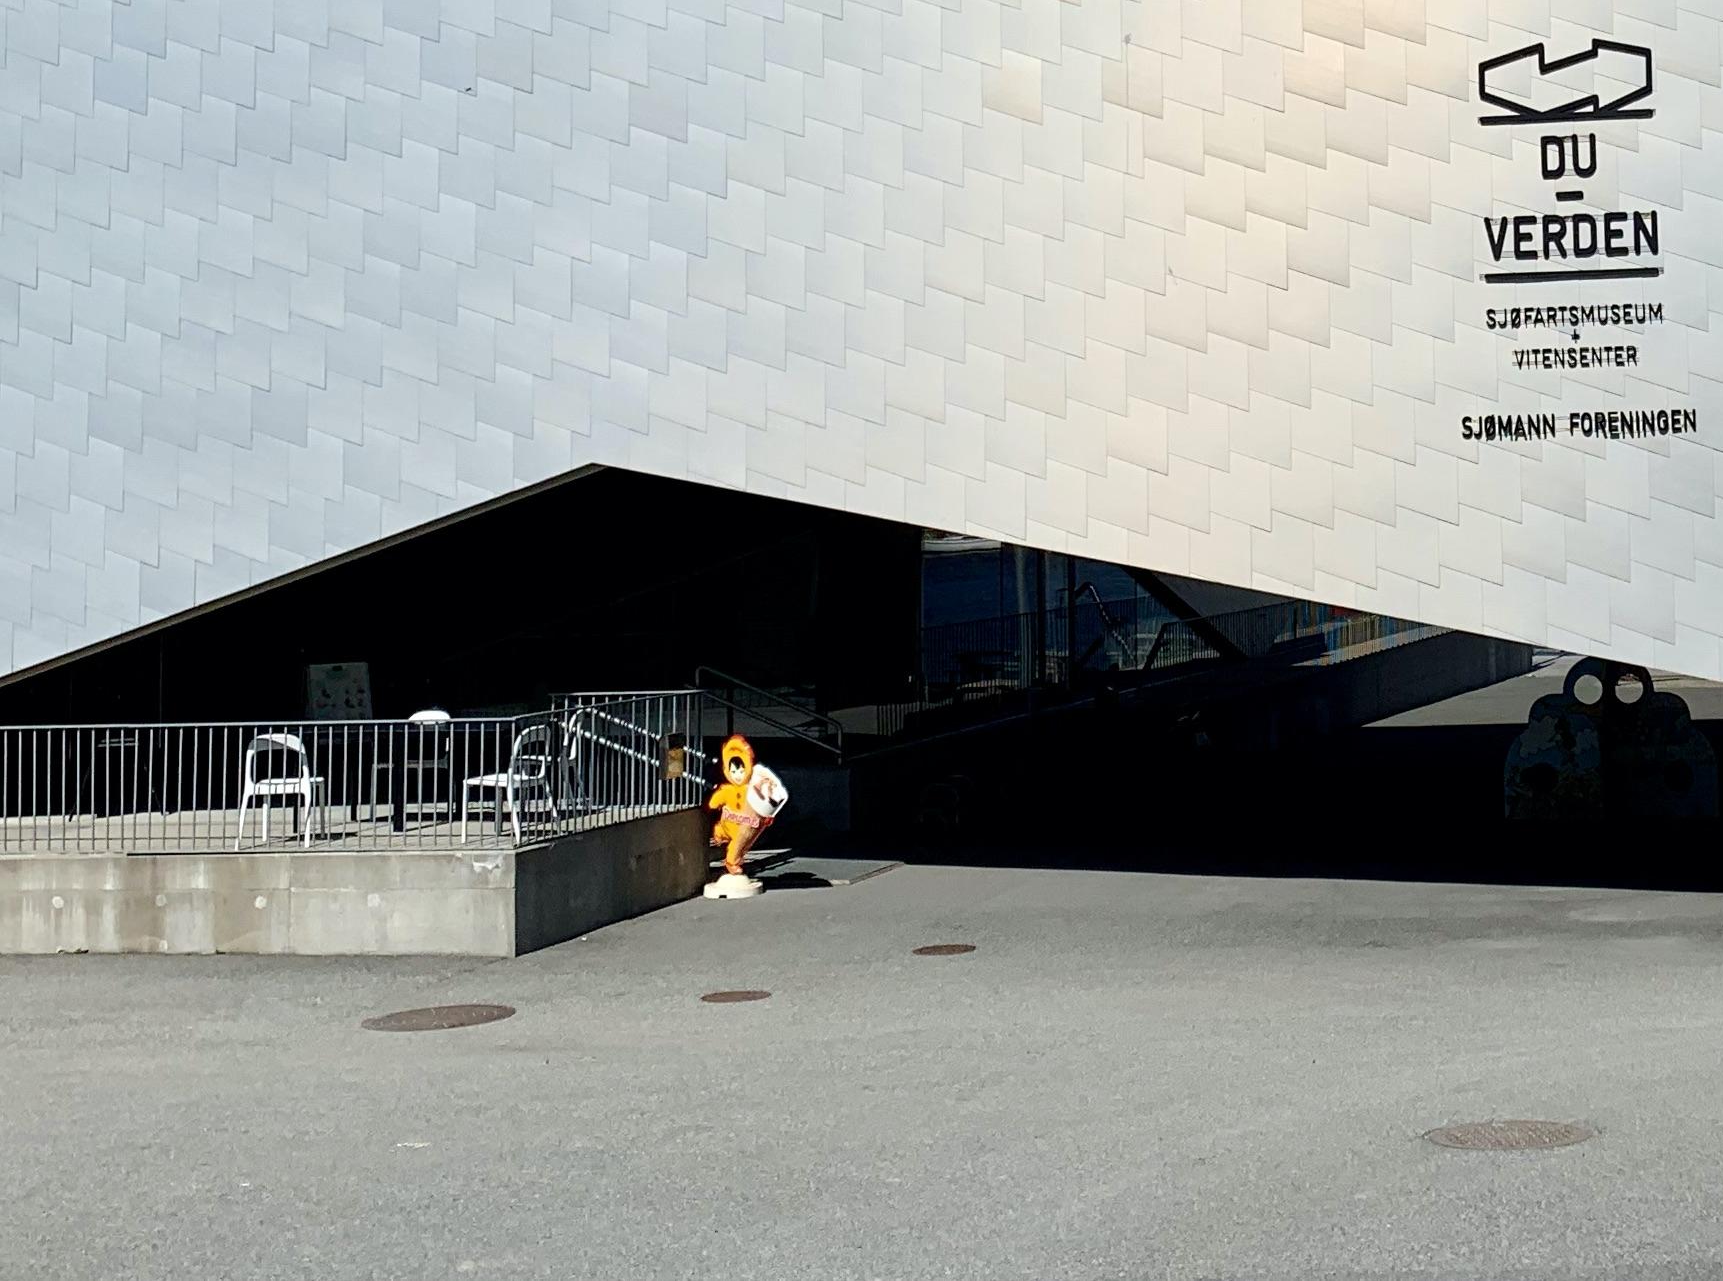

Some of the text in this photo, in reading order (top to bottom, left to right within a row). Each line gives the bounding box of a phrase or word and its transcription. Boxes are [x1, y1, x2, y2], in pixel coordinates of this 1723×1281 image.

[1540, 133, 1597, 180] DU
[1484, 210, 1659, 261] VERDEN
[1486, 303, 1664, 329] SJØFARTSMUSEUM
[1514, 345, 1638, 370] VITENSENTER
[1462, 409, 1697, 441] SJØMANN FORENINGEN
